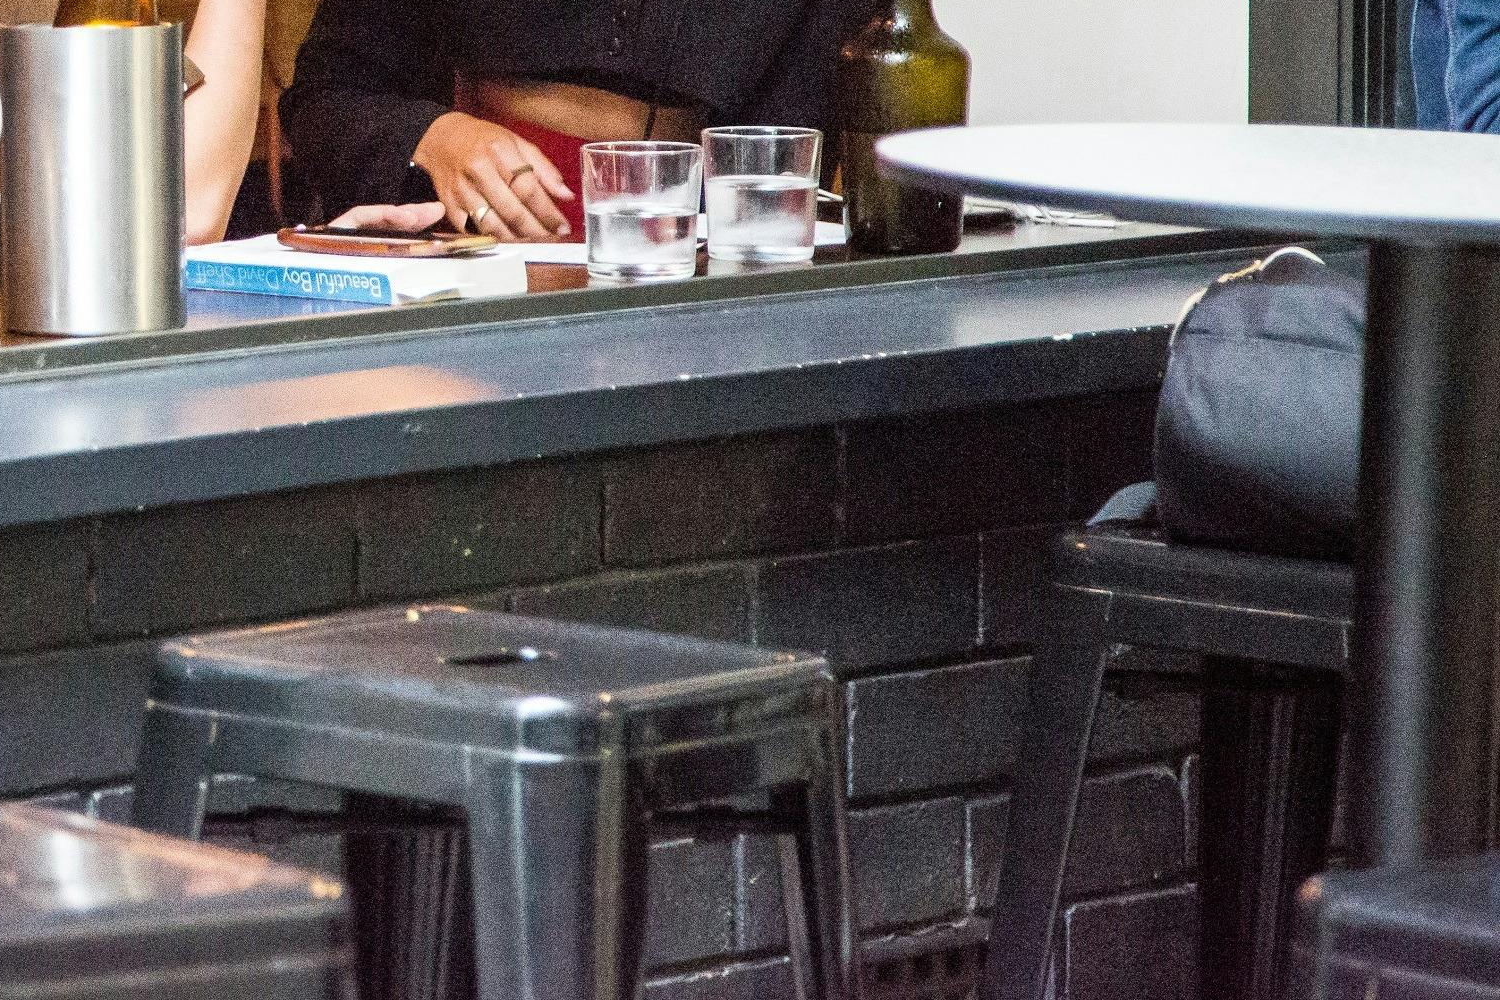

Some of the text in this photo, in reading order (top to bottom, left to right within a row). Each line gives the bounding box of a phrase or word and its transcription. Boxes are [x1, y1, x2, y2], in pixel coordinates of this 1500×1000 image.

[195, 264, 381, 297] Beautiful Boy David Sheff
